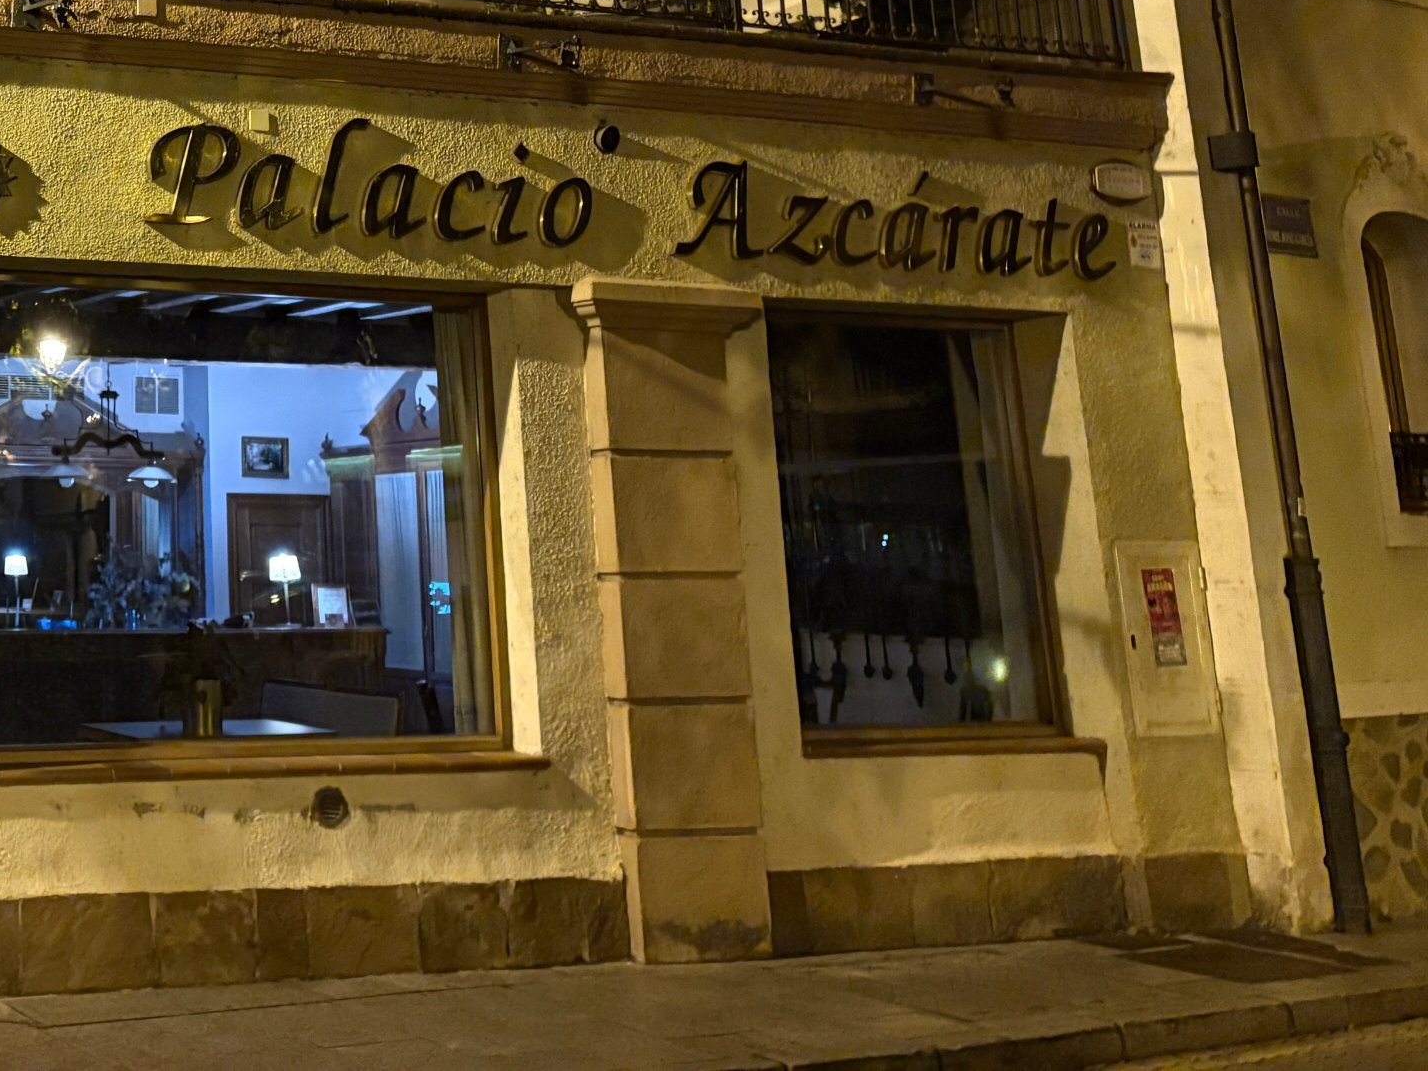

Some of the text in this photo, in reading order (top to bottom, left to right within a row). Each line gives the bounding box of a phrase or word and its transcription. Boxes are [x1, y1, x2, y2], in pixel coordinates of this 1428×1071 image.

[144, 117, 593, 247] Palacio
[673, 159, 1117, 281] Azcárate
[1129, 221, 1157, 231] ALARMA
